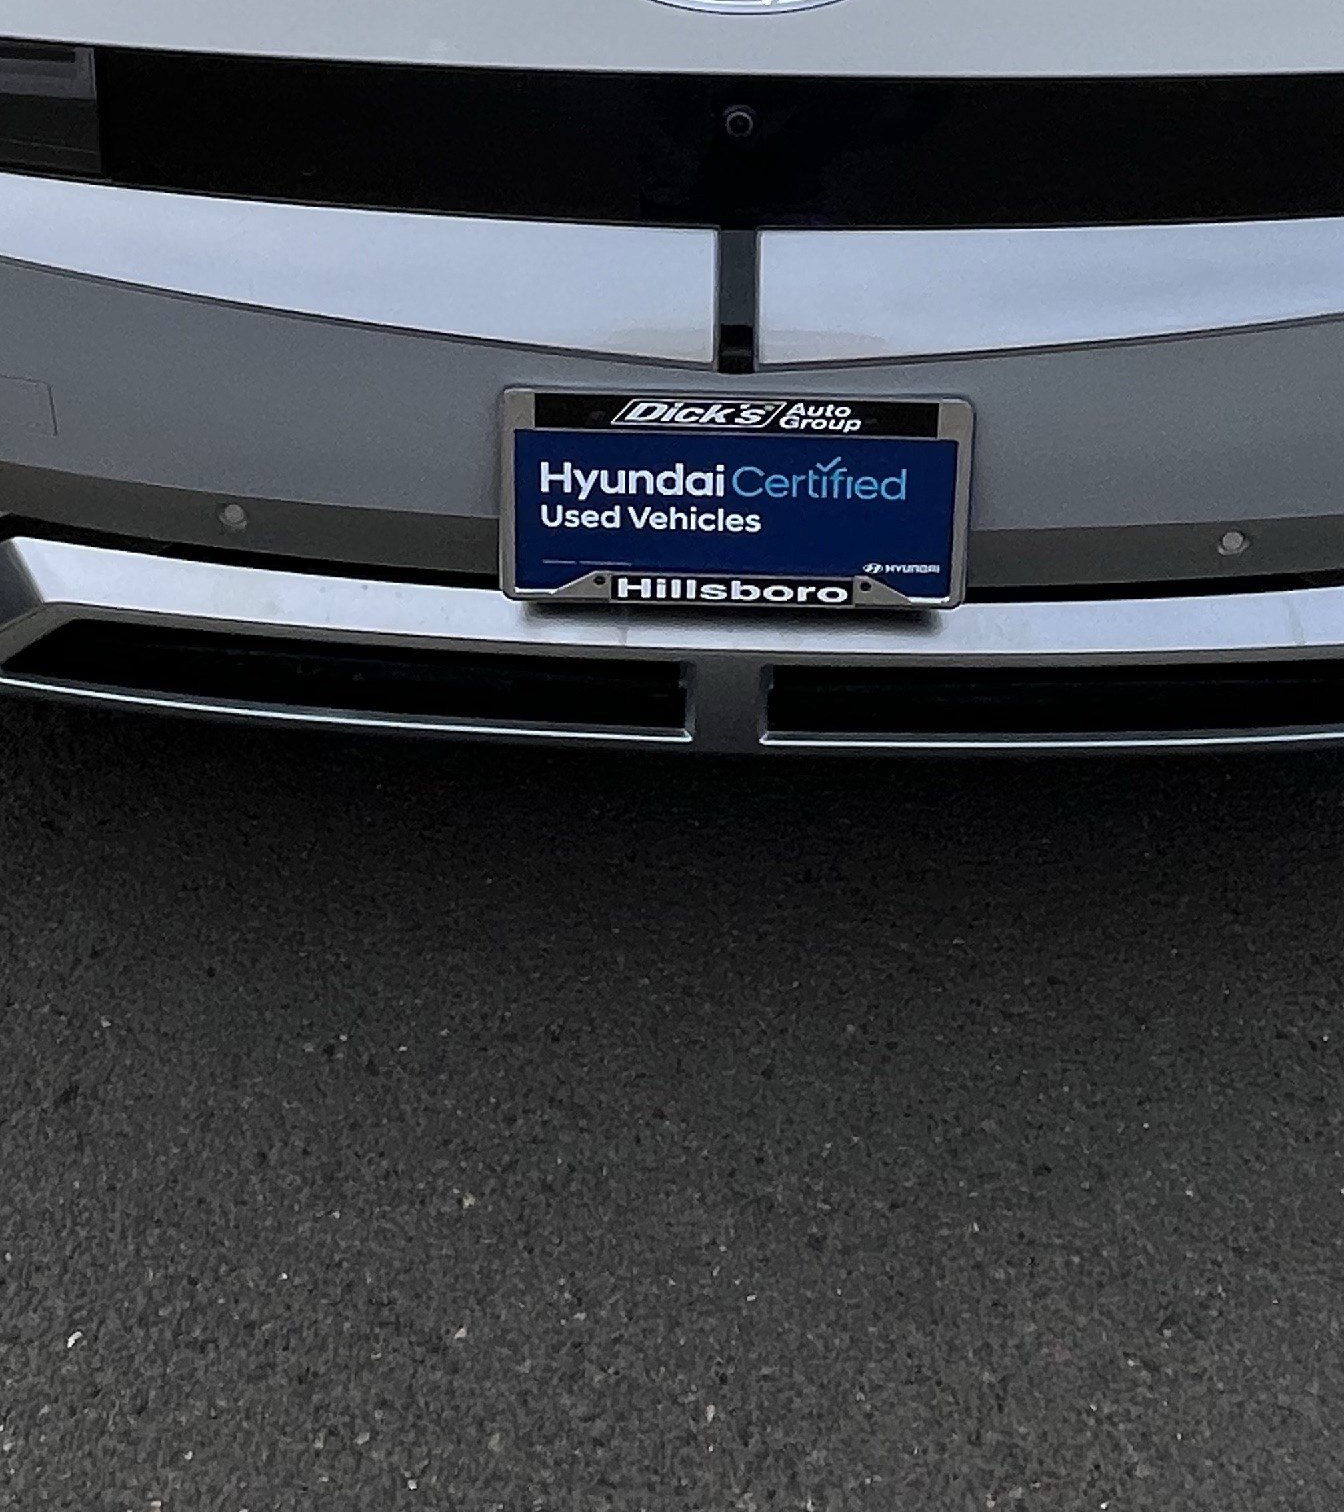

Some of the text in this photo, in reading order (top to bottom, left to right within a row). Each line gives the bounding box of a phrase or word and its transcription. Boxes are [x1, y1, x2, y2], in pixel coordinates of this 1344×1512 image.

[624, 401, 769, 426] Dick's
[790, 402, 852, 419] Auto
[779, 415, 862, 434] Group
[540, 457, 907, 502] Hyundai Certified
[540, 504, 762, 533] Used Vehicles
[884, 564, 940, 574] HYUNDAI
[615, 576, 849, 604] Hillsboro
